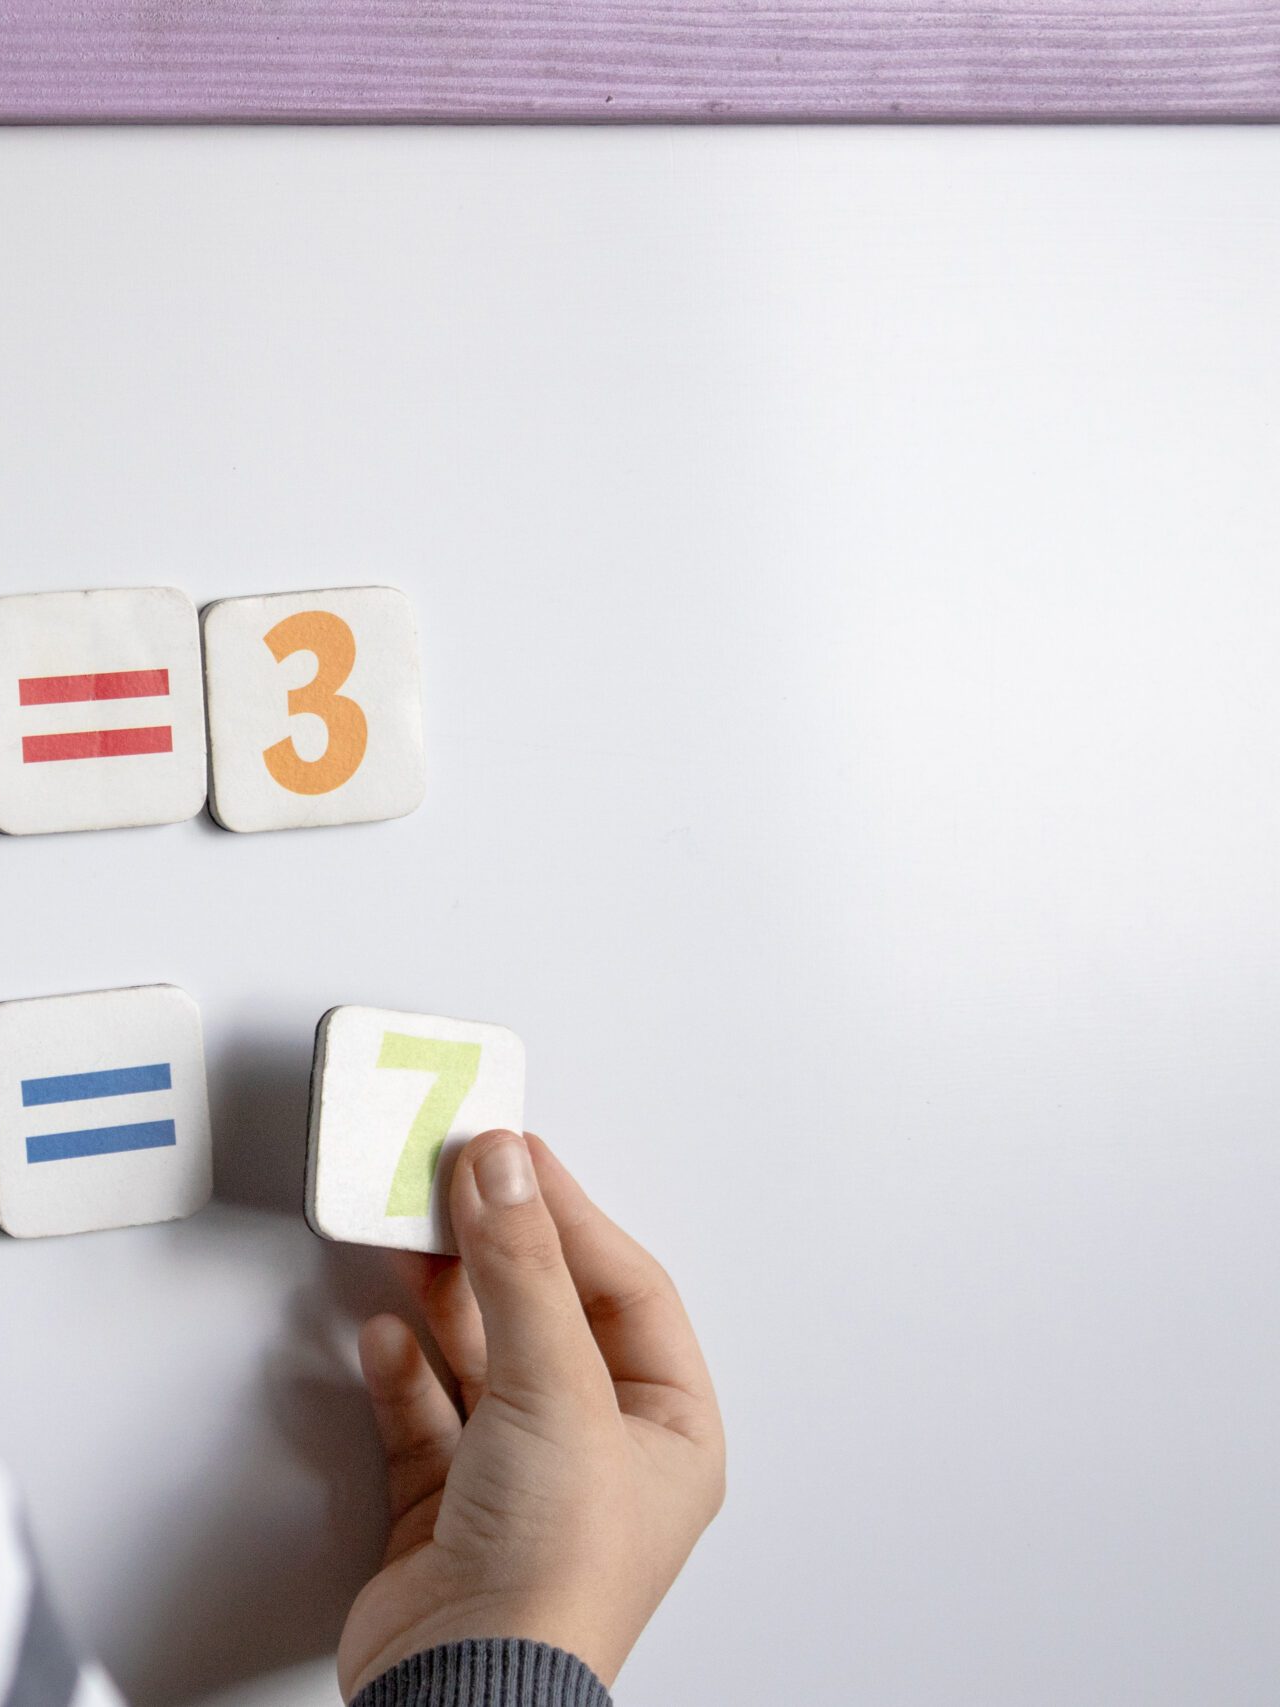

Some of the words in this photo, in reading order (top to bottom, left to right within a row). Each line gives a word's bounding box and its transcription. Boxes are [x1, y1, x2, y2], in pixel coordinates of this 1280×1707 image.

[19, 668, 173, 764] =
[263, 611, 368, 795] 3
[22, 1063, 176, 1164] =
[376, 1031, 482, 1218] 7
